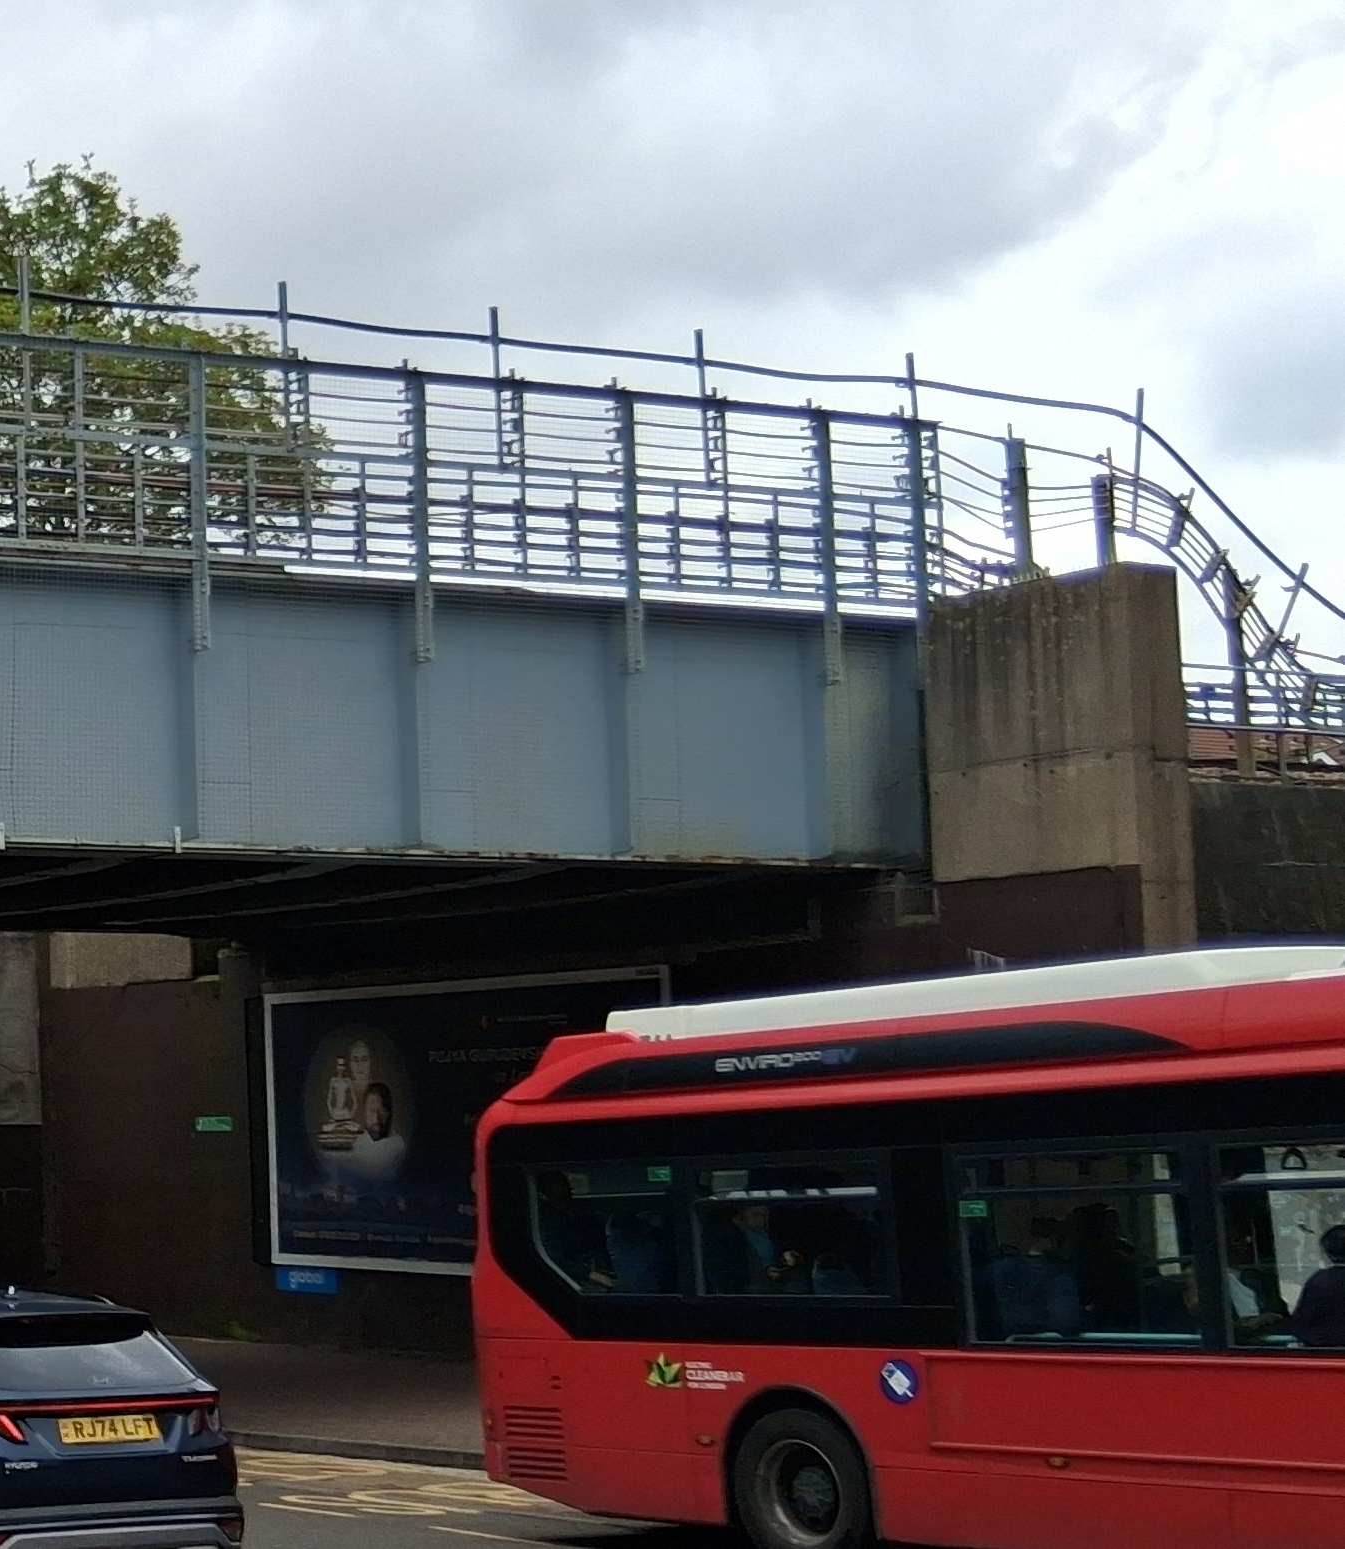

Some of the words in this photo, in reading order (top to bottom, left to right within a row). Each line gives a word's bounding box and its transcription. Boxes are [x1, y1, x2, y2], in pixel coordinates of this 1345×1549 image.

[288, 1269, 325, 1289] global
[73, 1420, 118, 1439] RJ74
[122, 1418, 154, 1437] LFT
